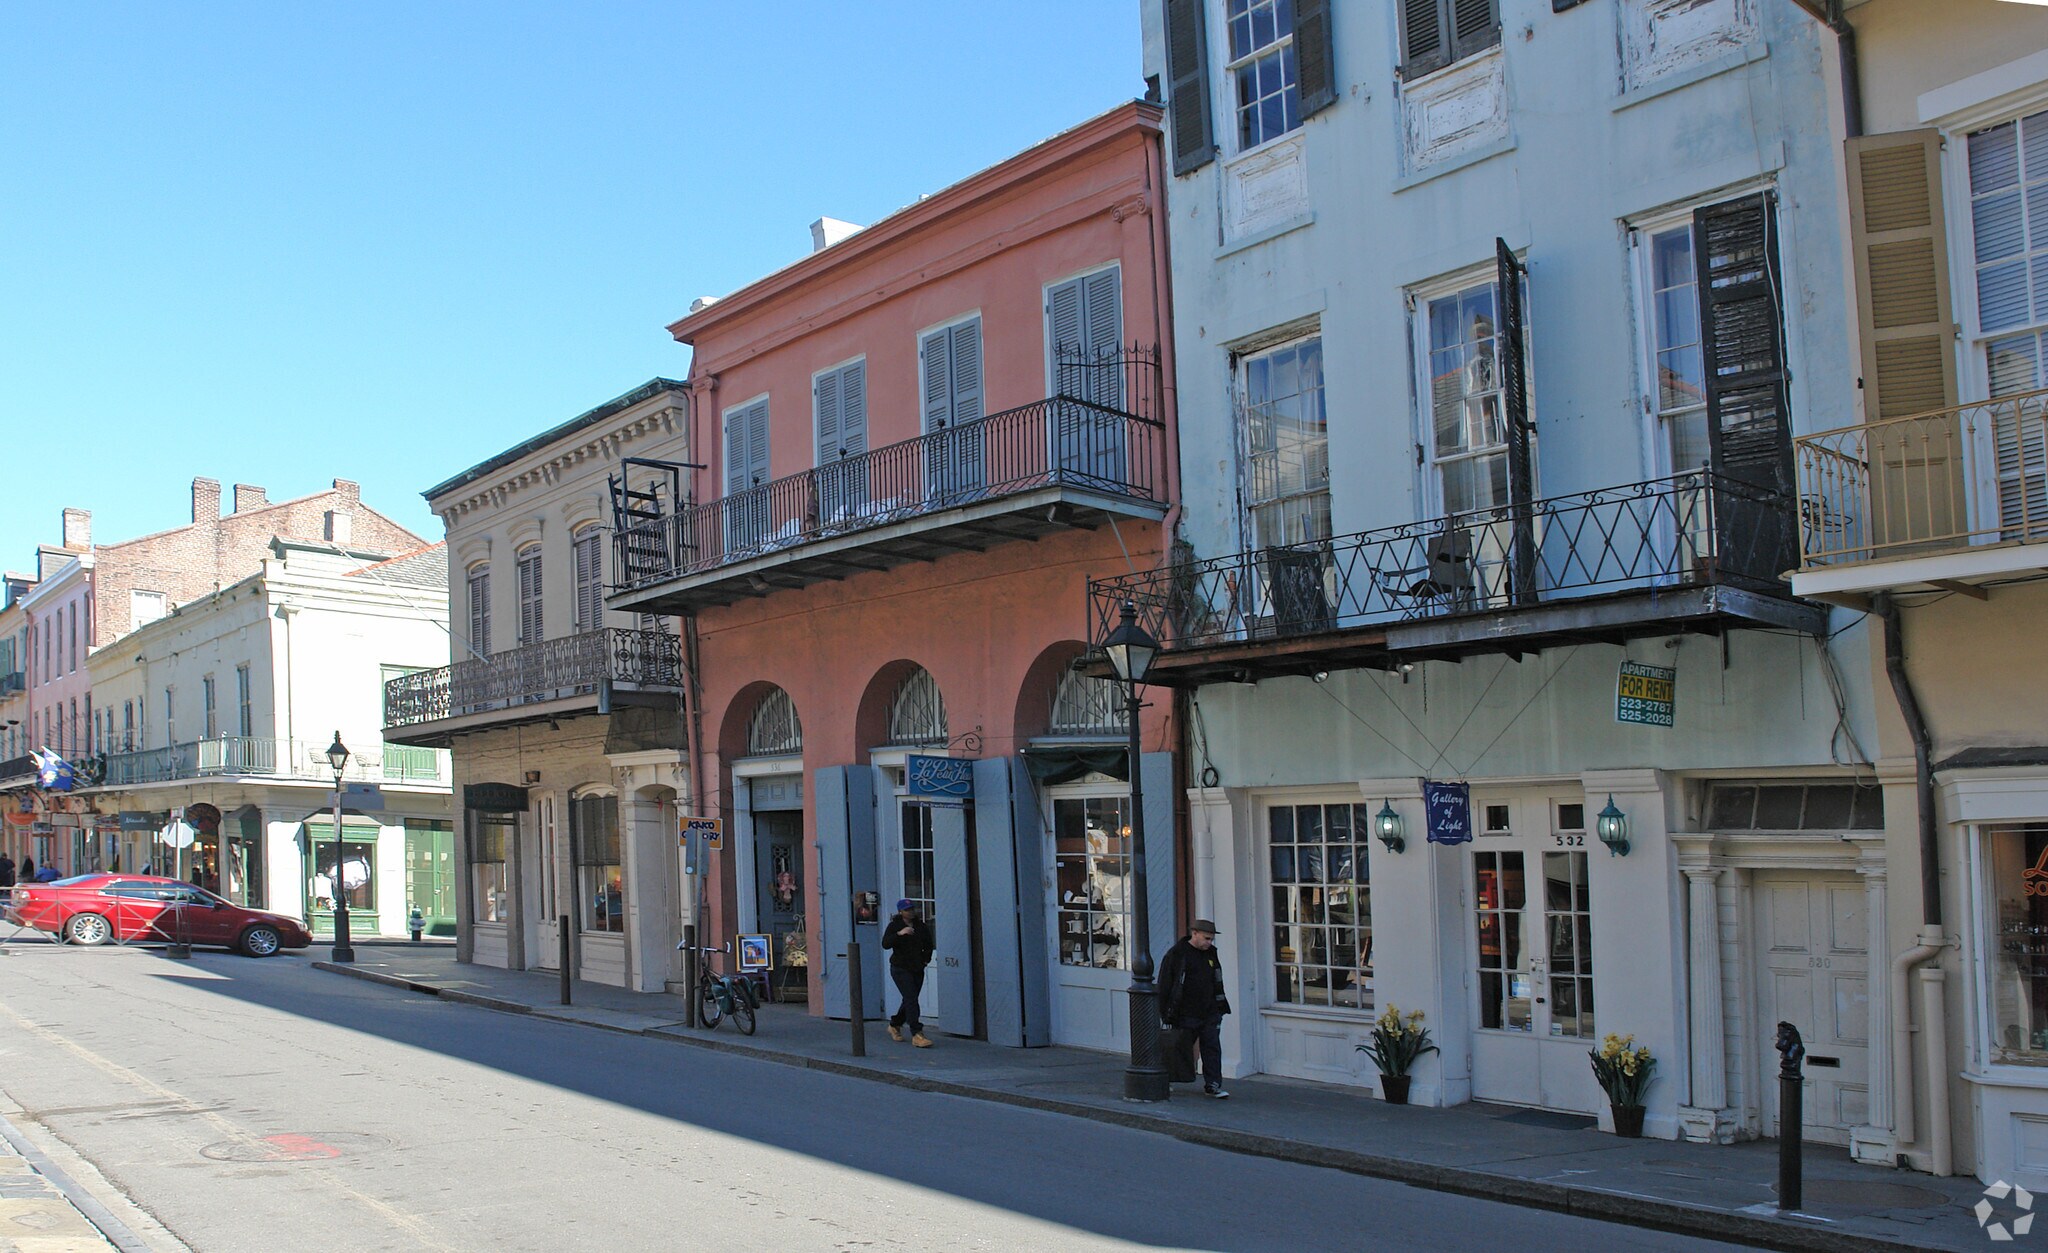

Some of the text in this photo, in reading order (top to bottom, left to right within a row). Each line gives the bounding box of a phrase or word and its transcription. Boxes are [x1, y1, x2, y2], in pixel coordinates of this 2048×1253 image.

[1622, 664, 1674, 681] APARTMENT
[1621, 676, 1673, 700] FOR RENT
[1620, 698, 1672, 713] 523-2787
[1620, 709, 1672, 724] 525-2028
[911, 758, 932, 781] La
[1431, 791, 1464, 807] Gallery
[1443, 806, 1453, 818] of
[688, 820, 715, 829] KAKO
[1437, 819, 1463, 833] Light
[1556, 836, 1584, 846] 532
